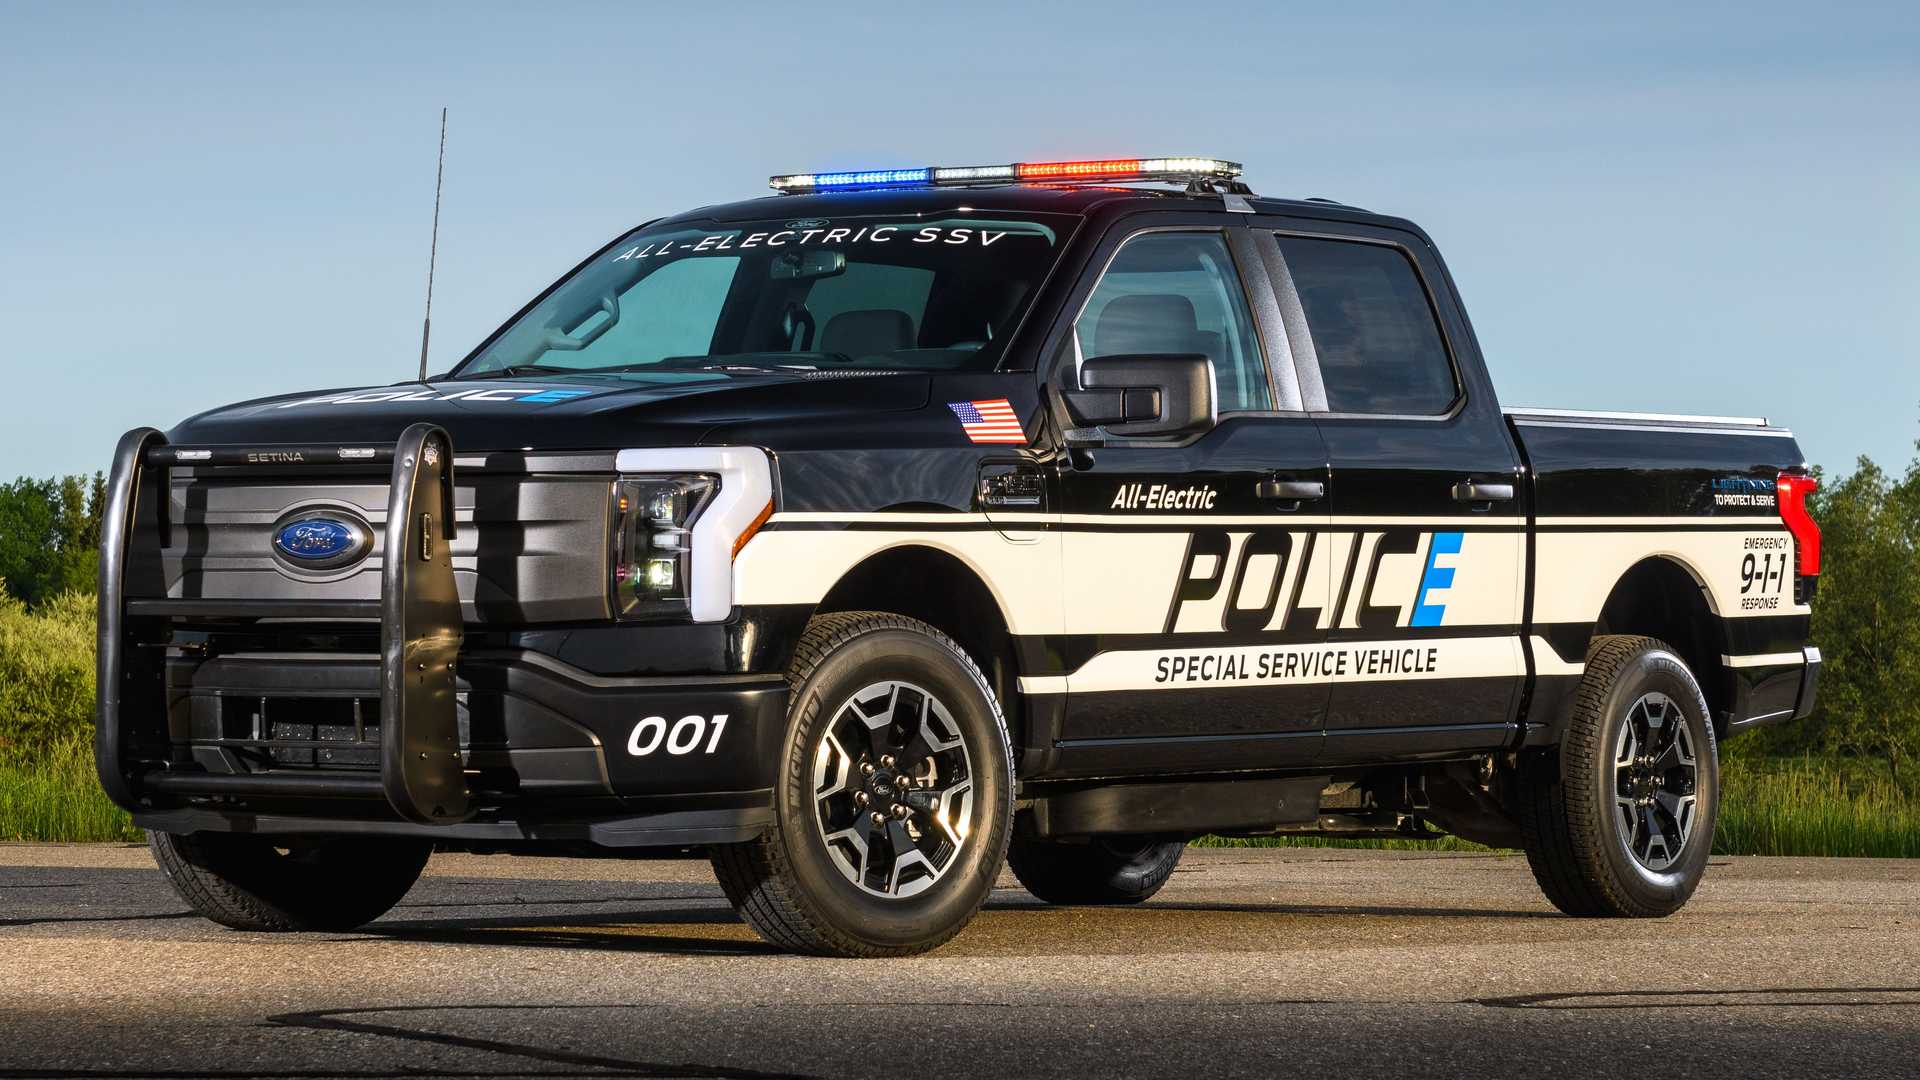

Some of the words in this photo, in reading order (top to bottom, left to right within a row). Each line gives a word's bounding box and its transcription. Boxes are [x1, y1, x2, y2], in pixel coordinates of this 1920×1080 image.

[613, 227, 899, 263] ALL-ELECTRIC
[912, 227, 1007, 246] SSV
[278, 389, 592, 409] POLICE
[247, 452, 305, 462] SETINA
[1111, 484, 1217, 510] All-Electric
[1714, 494, 1723, 505] TO
[1724, 494, 1750, 506] PROTECT
[1751, 495, 1756, 506] &
[1756, 495, 1775, 506] SERVE
[1744, 537, 1788, 550] EMERGENCY
[1162, 531, 1465, 634] POLICE
[1740, 552, 1787, 594] 9-1-1
[1741, 597, 1779, 610] RESPONSE
[1154, 655, 1249, 683] SPECIAL
[1255, 650, 1347, 679] SERVICE
[1354, 647, 1438, 674] VEHICLE
[627, 714, 729, 757] 001
